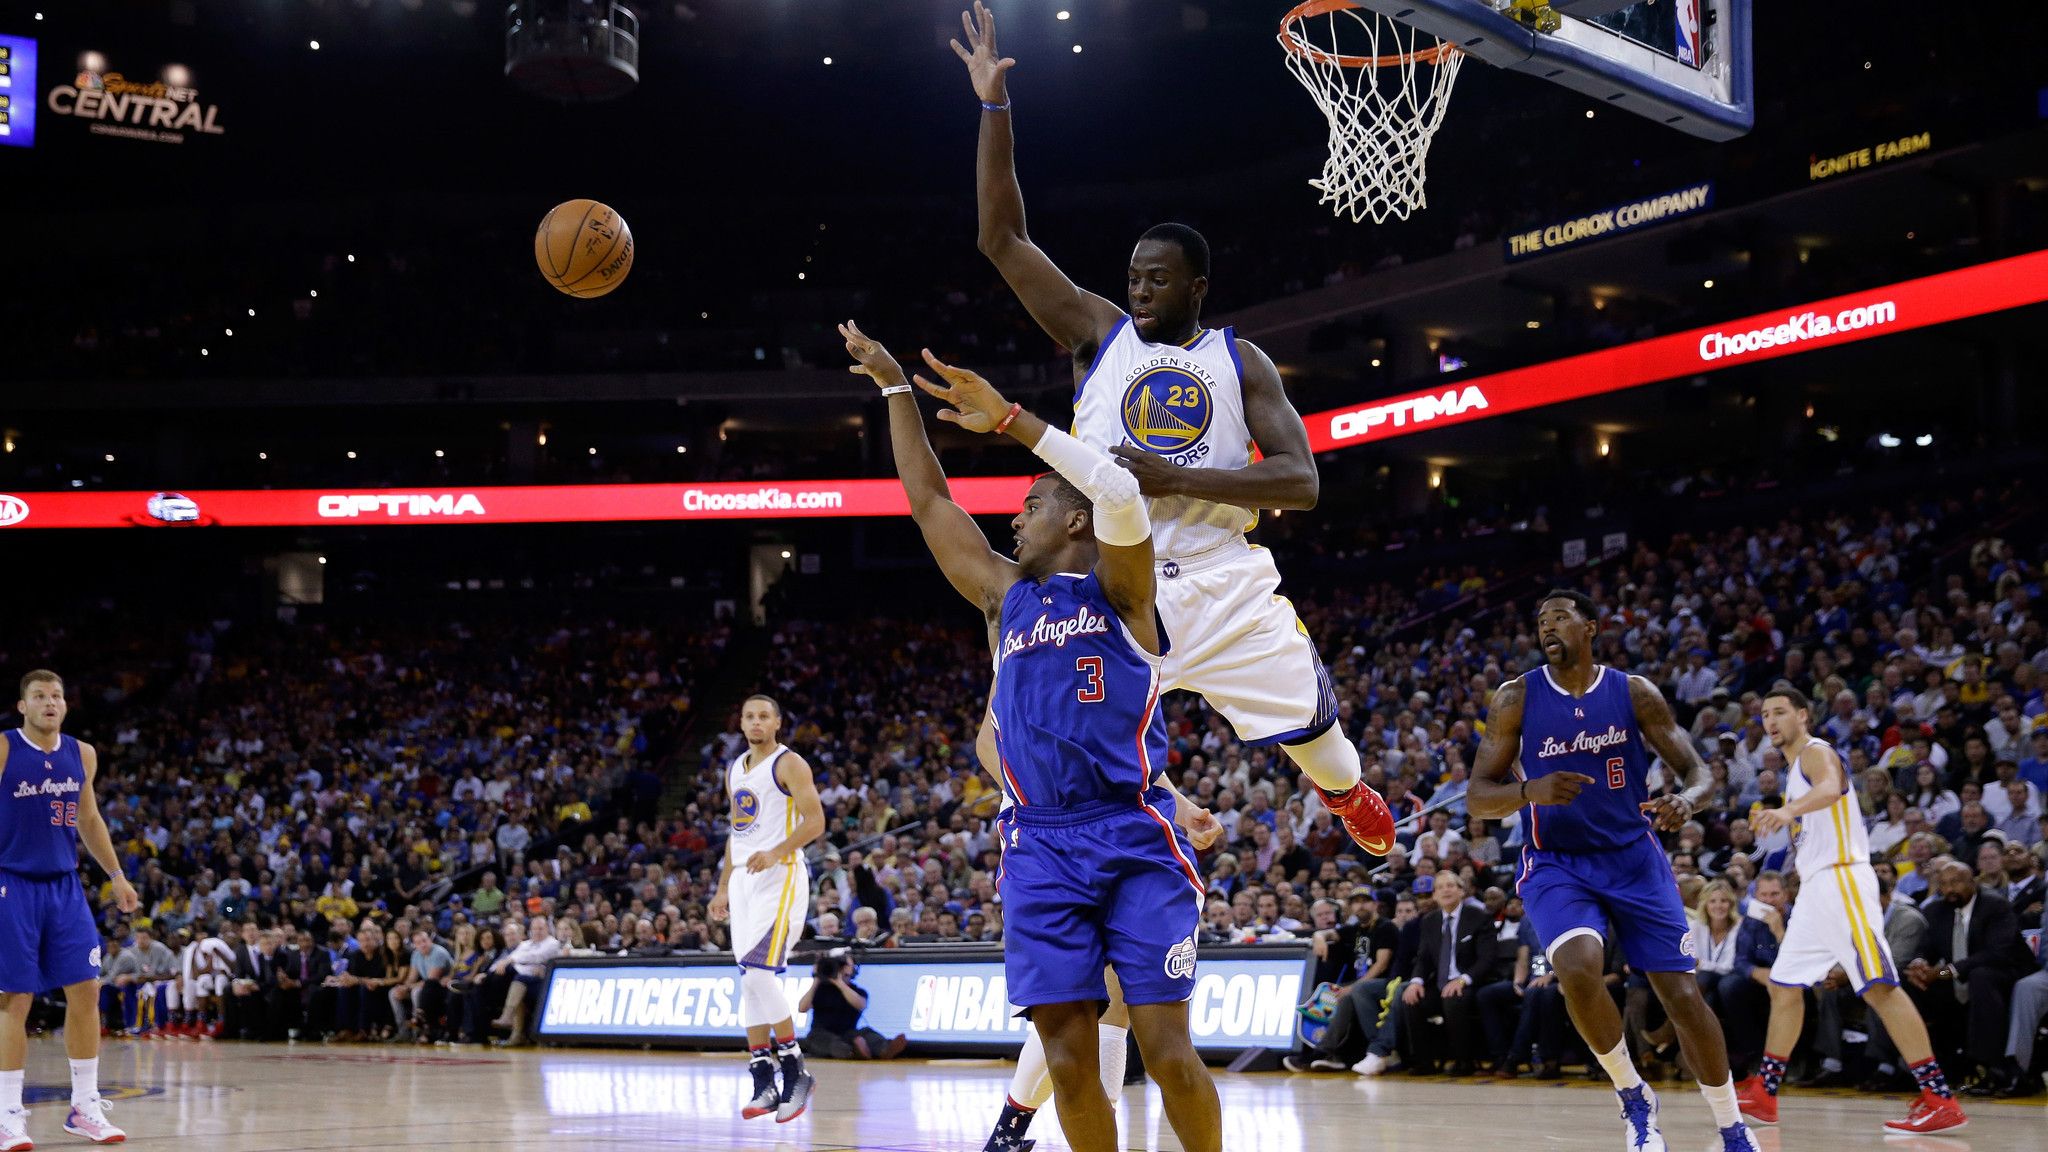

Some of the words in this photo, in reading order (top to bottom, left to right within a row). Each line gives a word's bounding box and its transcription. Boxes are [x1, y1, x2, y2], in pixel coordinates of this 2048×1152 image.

[48, 84, 225, 135] CENTRAL
[1875, 131, 1931, 162] FARM
[1508, 229, 1543, 256] THE
[1543, 210, 1616, 248] CLOROX
[1615, 184, 1710, 228] COMPANY
[1699, 301, 1897, 361] ChooseKia.com
[1125, 357, 1179, 383] GOLDEN
[1182, 361, 1218, 391] STATE
[1165, 385, 1200, 408] 23
[1330, 385, 1489, 440] OPTIMA
[317, 494, 486, 518] OPTIMA
[683, 488, 843, 511] ChooseKia.com
[1001, 629, 1026, 663] Los
[1028, 606, 1109, 648] Angeles
[1076, 655, 1105, 703] 3
[1538, 736, 1567, 758] Los
[1569, 725, 1628, 754] Angeles
[13, 780, 38, 798] Los
[38, 776, 80, 797] Angeles
[1606, 756, 1626, 790] 6
[50, 799, 79, 827] 32
[741, 795, 754, 808] 30
